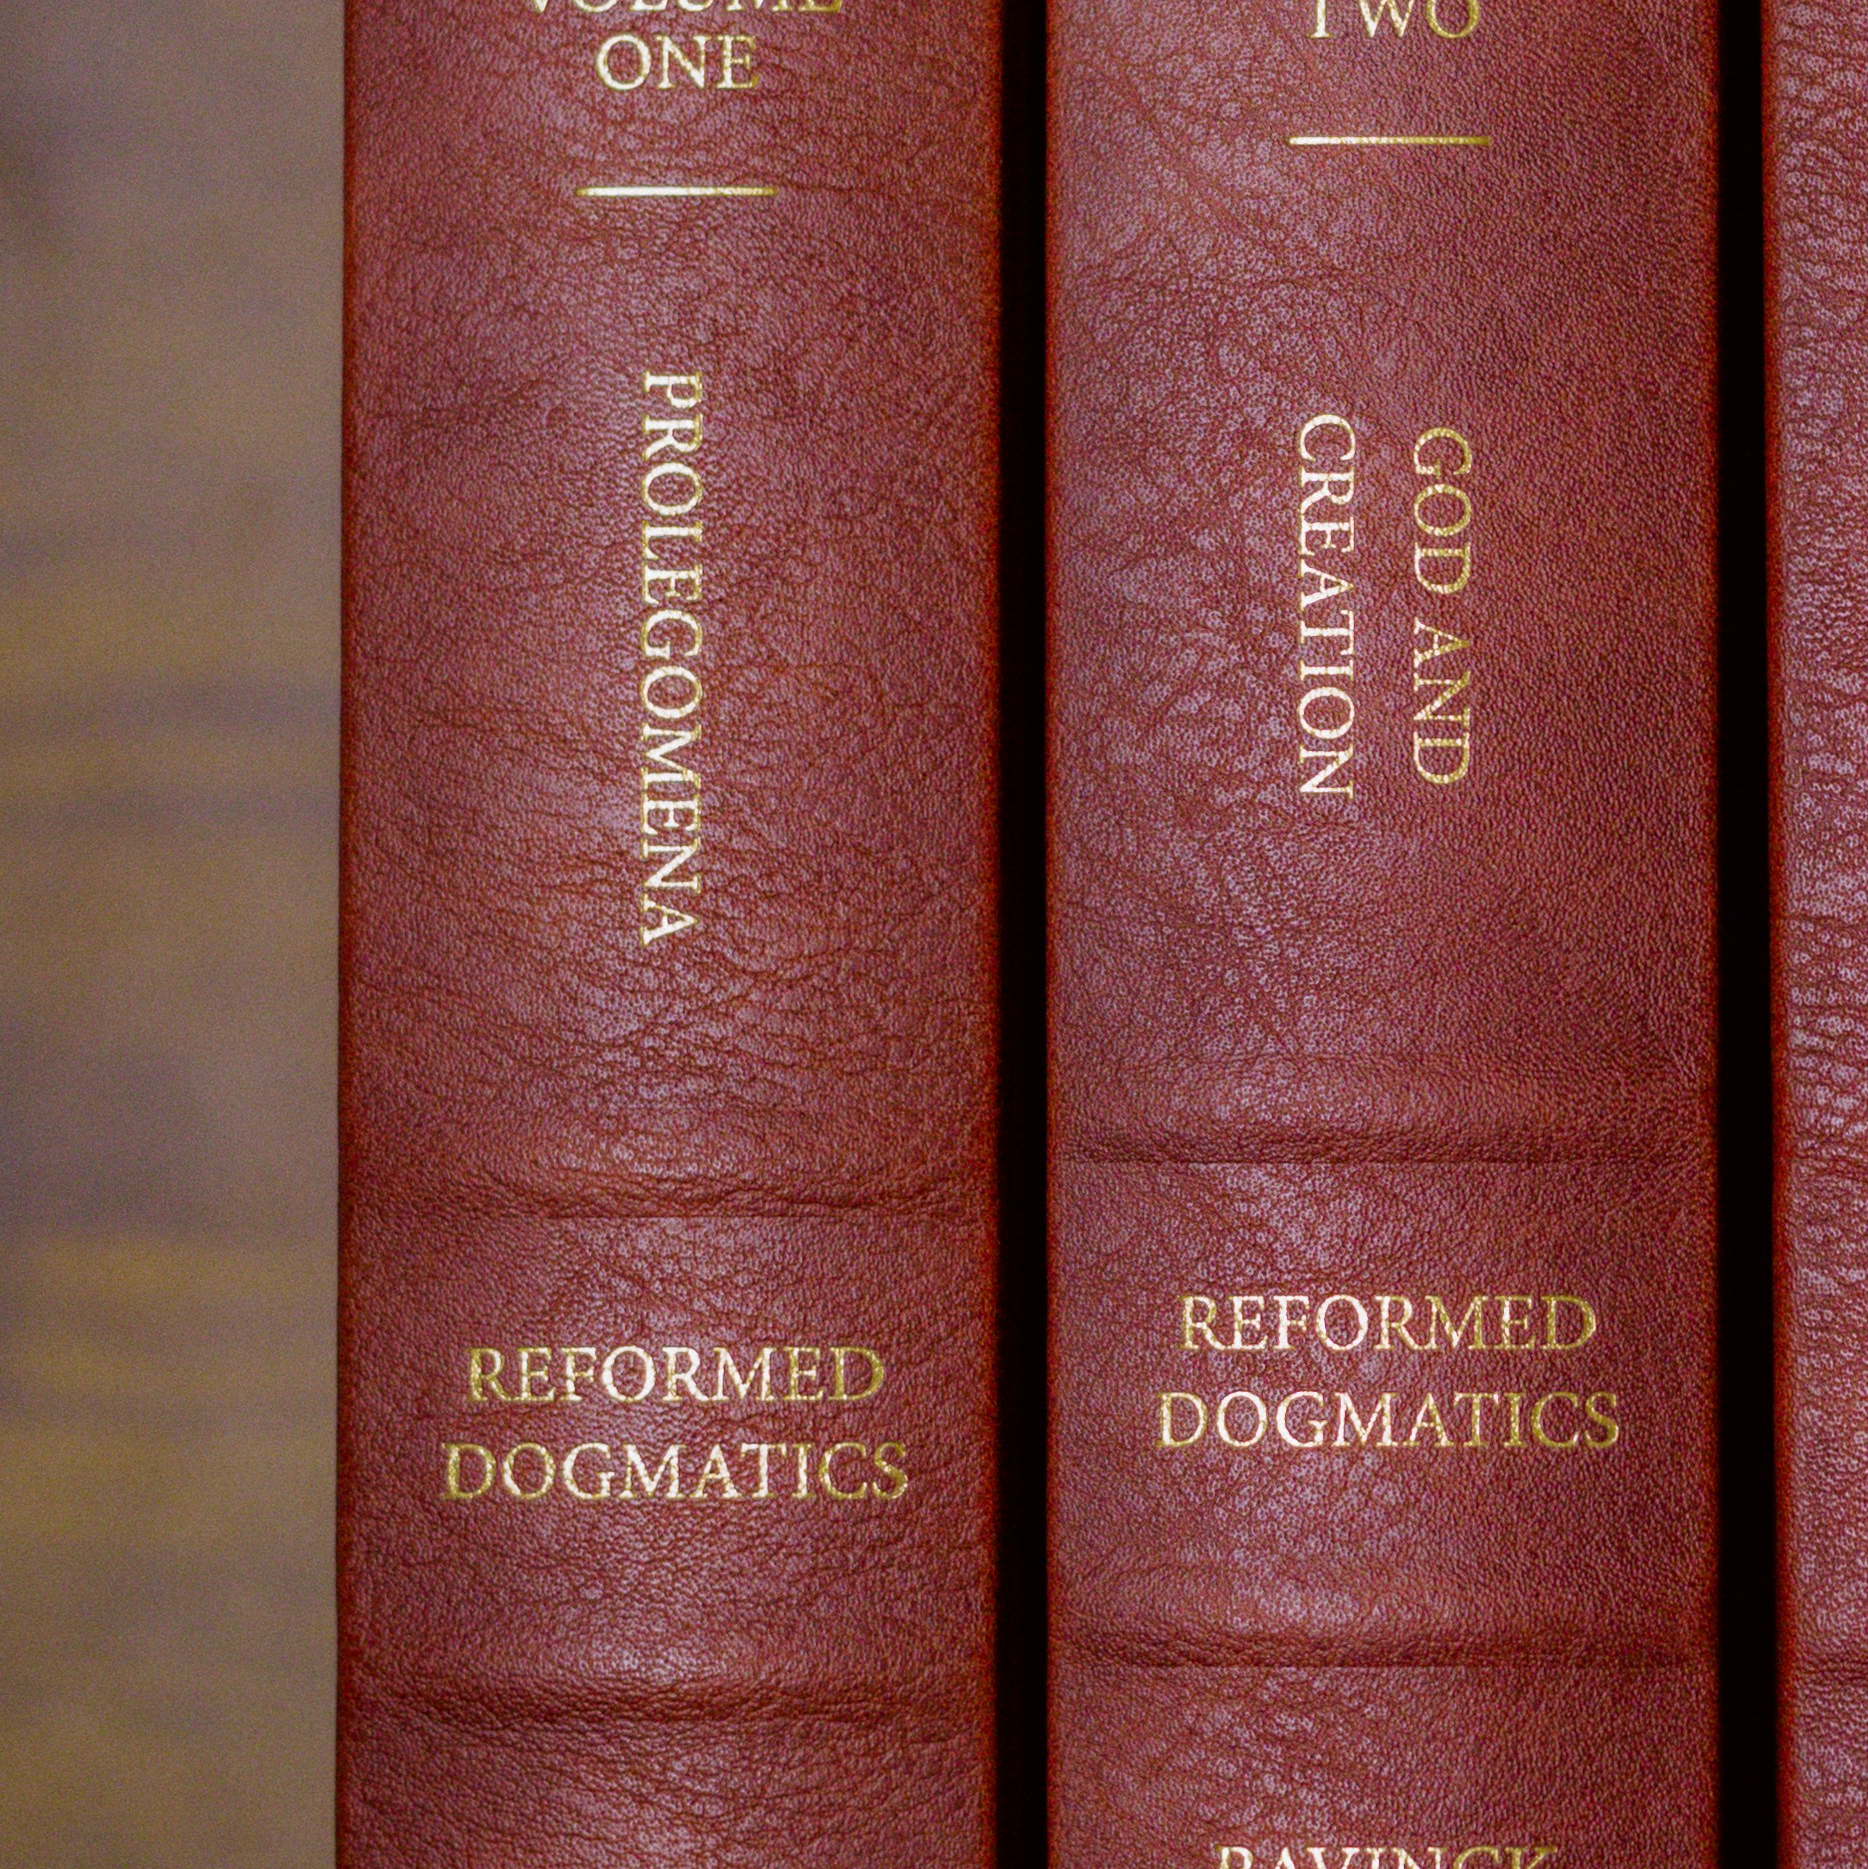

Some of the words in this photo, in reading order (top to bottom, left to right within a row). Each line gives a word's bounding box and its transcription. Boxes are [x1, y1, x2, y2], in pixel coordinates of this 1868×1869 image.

[595, 34, 759, 93] ONE
[1409, 427, 1472, 596] GOD
[1294, 413, 1357, 800] CREATION
[640, 370, 705, 946] PROLEGOMENA
[1409, 618, 1472, 786] AND
[1178, 1295, 1597, 1354] REFORMED
[465, 1346, 885, 1406] REFORMED
[1156, 1390, 1620, 1453] DOGMATICS
[441, 1442, 910, 1505] DOGMATICS
